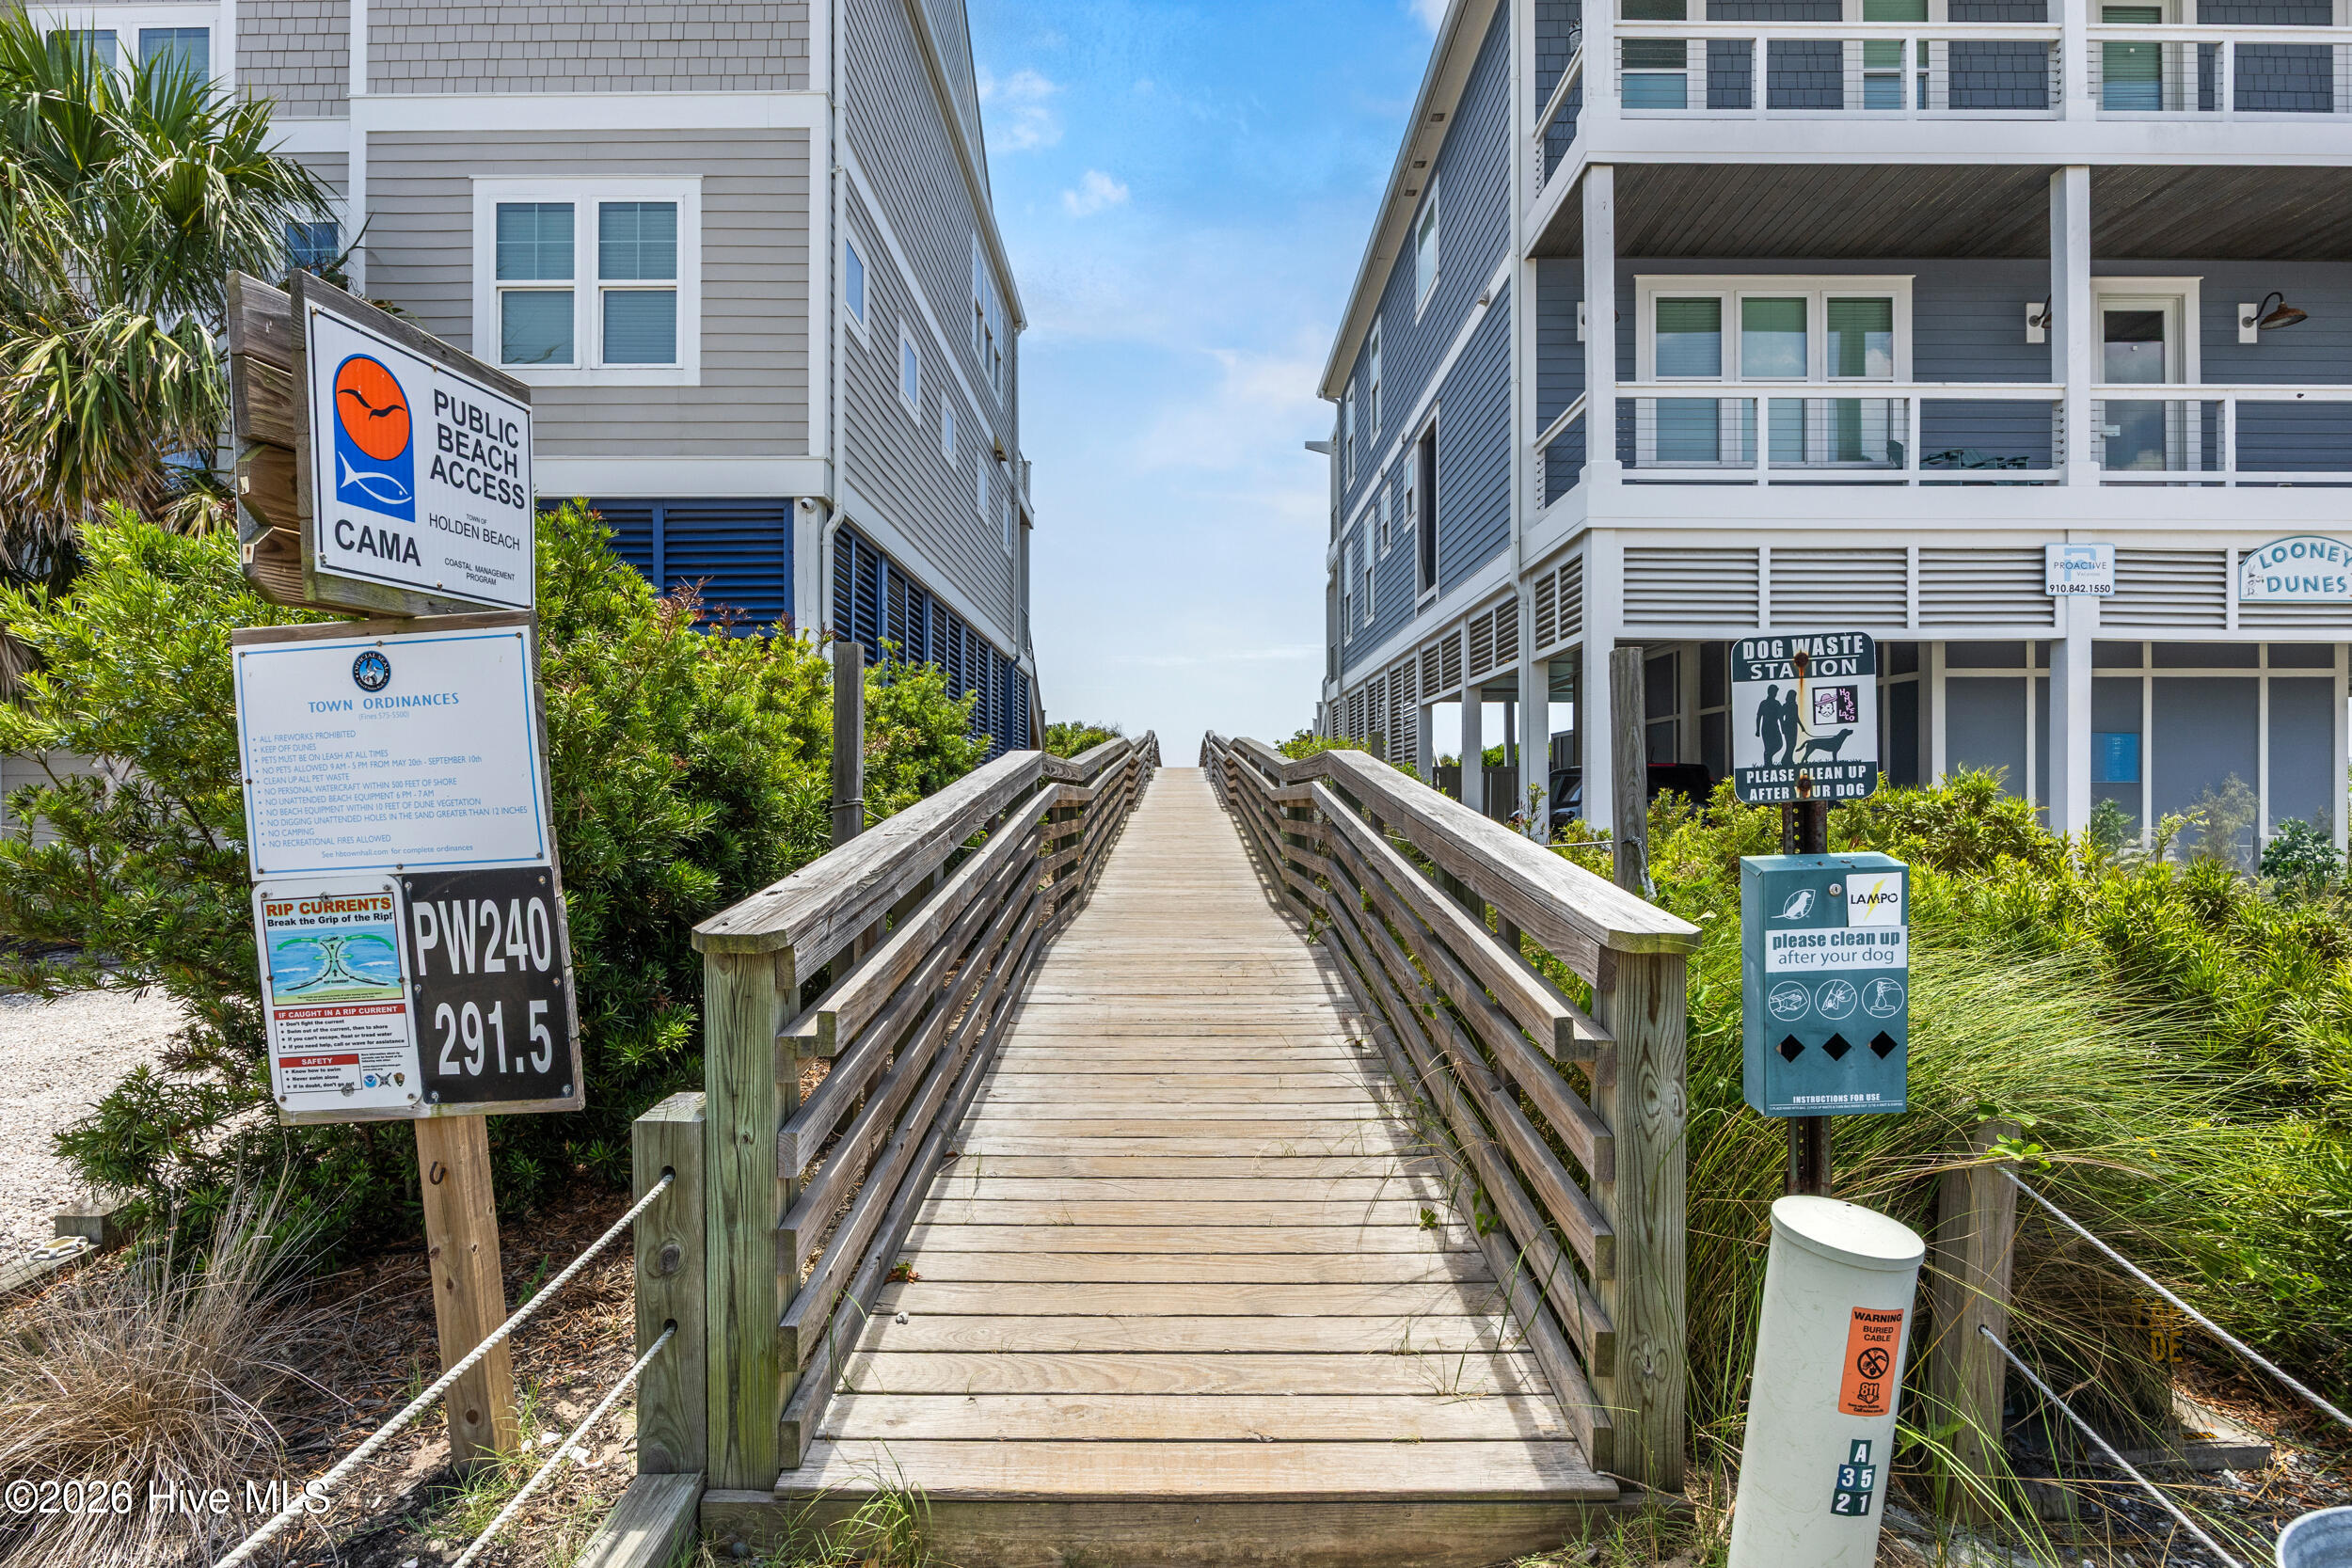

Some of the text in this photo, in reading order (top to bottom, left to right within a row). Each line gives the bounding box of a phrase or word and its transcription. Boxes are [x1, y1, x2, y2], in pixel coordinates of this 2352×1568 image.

[434, 388, 518, 449] PUBLIC
[437, 422, 517, 478] BEACH
[430, 454, 525, 510] ACCESS
[466, 514, 479, 524] TOWN
[429, 513, 519, 551] HOLDEN BEACH
[334, 519, 421, 566] CAMA
[2258, 542, 2352, 569] LOONEY
[444, 557, 515, 580] COASTAL MANAGEMENT
[2054, 562, 2107, 570] PROACTIVE
[466, 572, 497, 586] PROGRAM
[2266, 575, 2347, 593] DUNES
[2049, 584, 2110, 593] 910.842.1550
[1742, 635, 1864, 660] DOG WASTE
[1750, 659, 1857, 680] STAION
[308, 692, 460, 713] TOWN ORDINANCES
[274, 729, 356, 742] FIREWORKS PROHIBITED
[293, 743, 316, 752] DUNES
[368, 749, 389, 758] TIMES
[294, 763, 328, 772] ALLOWED
[429, 756, 466, 765] SEPTEMBER
[469, 755, 482, 763] 10th
[326, 773, 350, 781] WASTE
[1746, 765, 1867, 784] PLEASE CLEAN UP
[315, 782, 360, 792] WATERCRAFT
[433, 777, 457, 786] SHORE
[1749, 786, 1789, 800] AFTER
[1836, 783, 1865, 797] DOG
[279, 796, 326, 805] UNATTENDED
[354, 792, 394, 801] EQUIPMENT
[305, 805, 344, 815] EQUIPMENT
[414, 800, 435, 808] DUNE
[437, 798, 481, 807] VEGETATION
[281, 817, 312, 826] DIGGING
[314, 815, 362, 824] UNATTENDED
[365, 813, 387, 822] HOLES
[414, 811, 434, 819] SAND
[436, 809, 467, 818] GREATER
[468, 808, 490, 816] THAN
[501, 806, 528, 814] INCHES
[282, 828, 315, 837] CAMPING
[283, 838, 335, 847] RECREATIONAL
[356, 834, 391, 843] ALLOWED
[403, 847, 434, 855] complete
[266, 897, 392, 917] RIP CURRENTS
[1851, 893, 1898, 905] LAMPO
[267, 918, 297, 927] Break
[299, 917, 315, 925] the
[318, 915, 339, 925] Grip
[354, 913, 370, 922] the
[412, 897, 551, 976] PW240
[1772, 931, 1900, 950] please clean up
[1779, 948, 1894, 966] after your dog
[435, 999, 553, 1077] 291.5
[1793, 1095, 1849, 1104] INSTRUCTIONS
[1854, 1311, 1902, 1323] WARNING
[1863, 1325, 1894, 1334] BURIED
[1864, 1334, 1891, 1342] CABLE
[1859, 1382, 1880, 1397] 811
[1854, 1442, 1867, 1463] A
